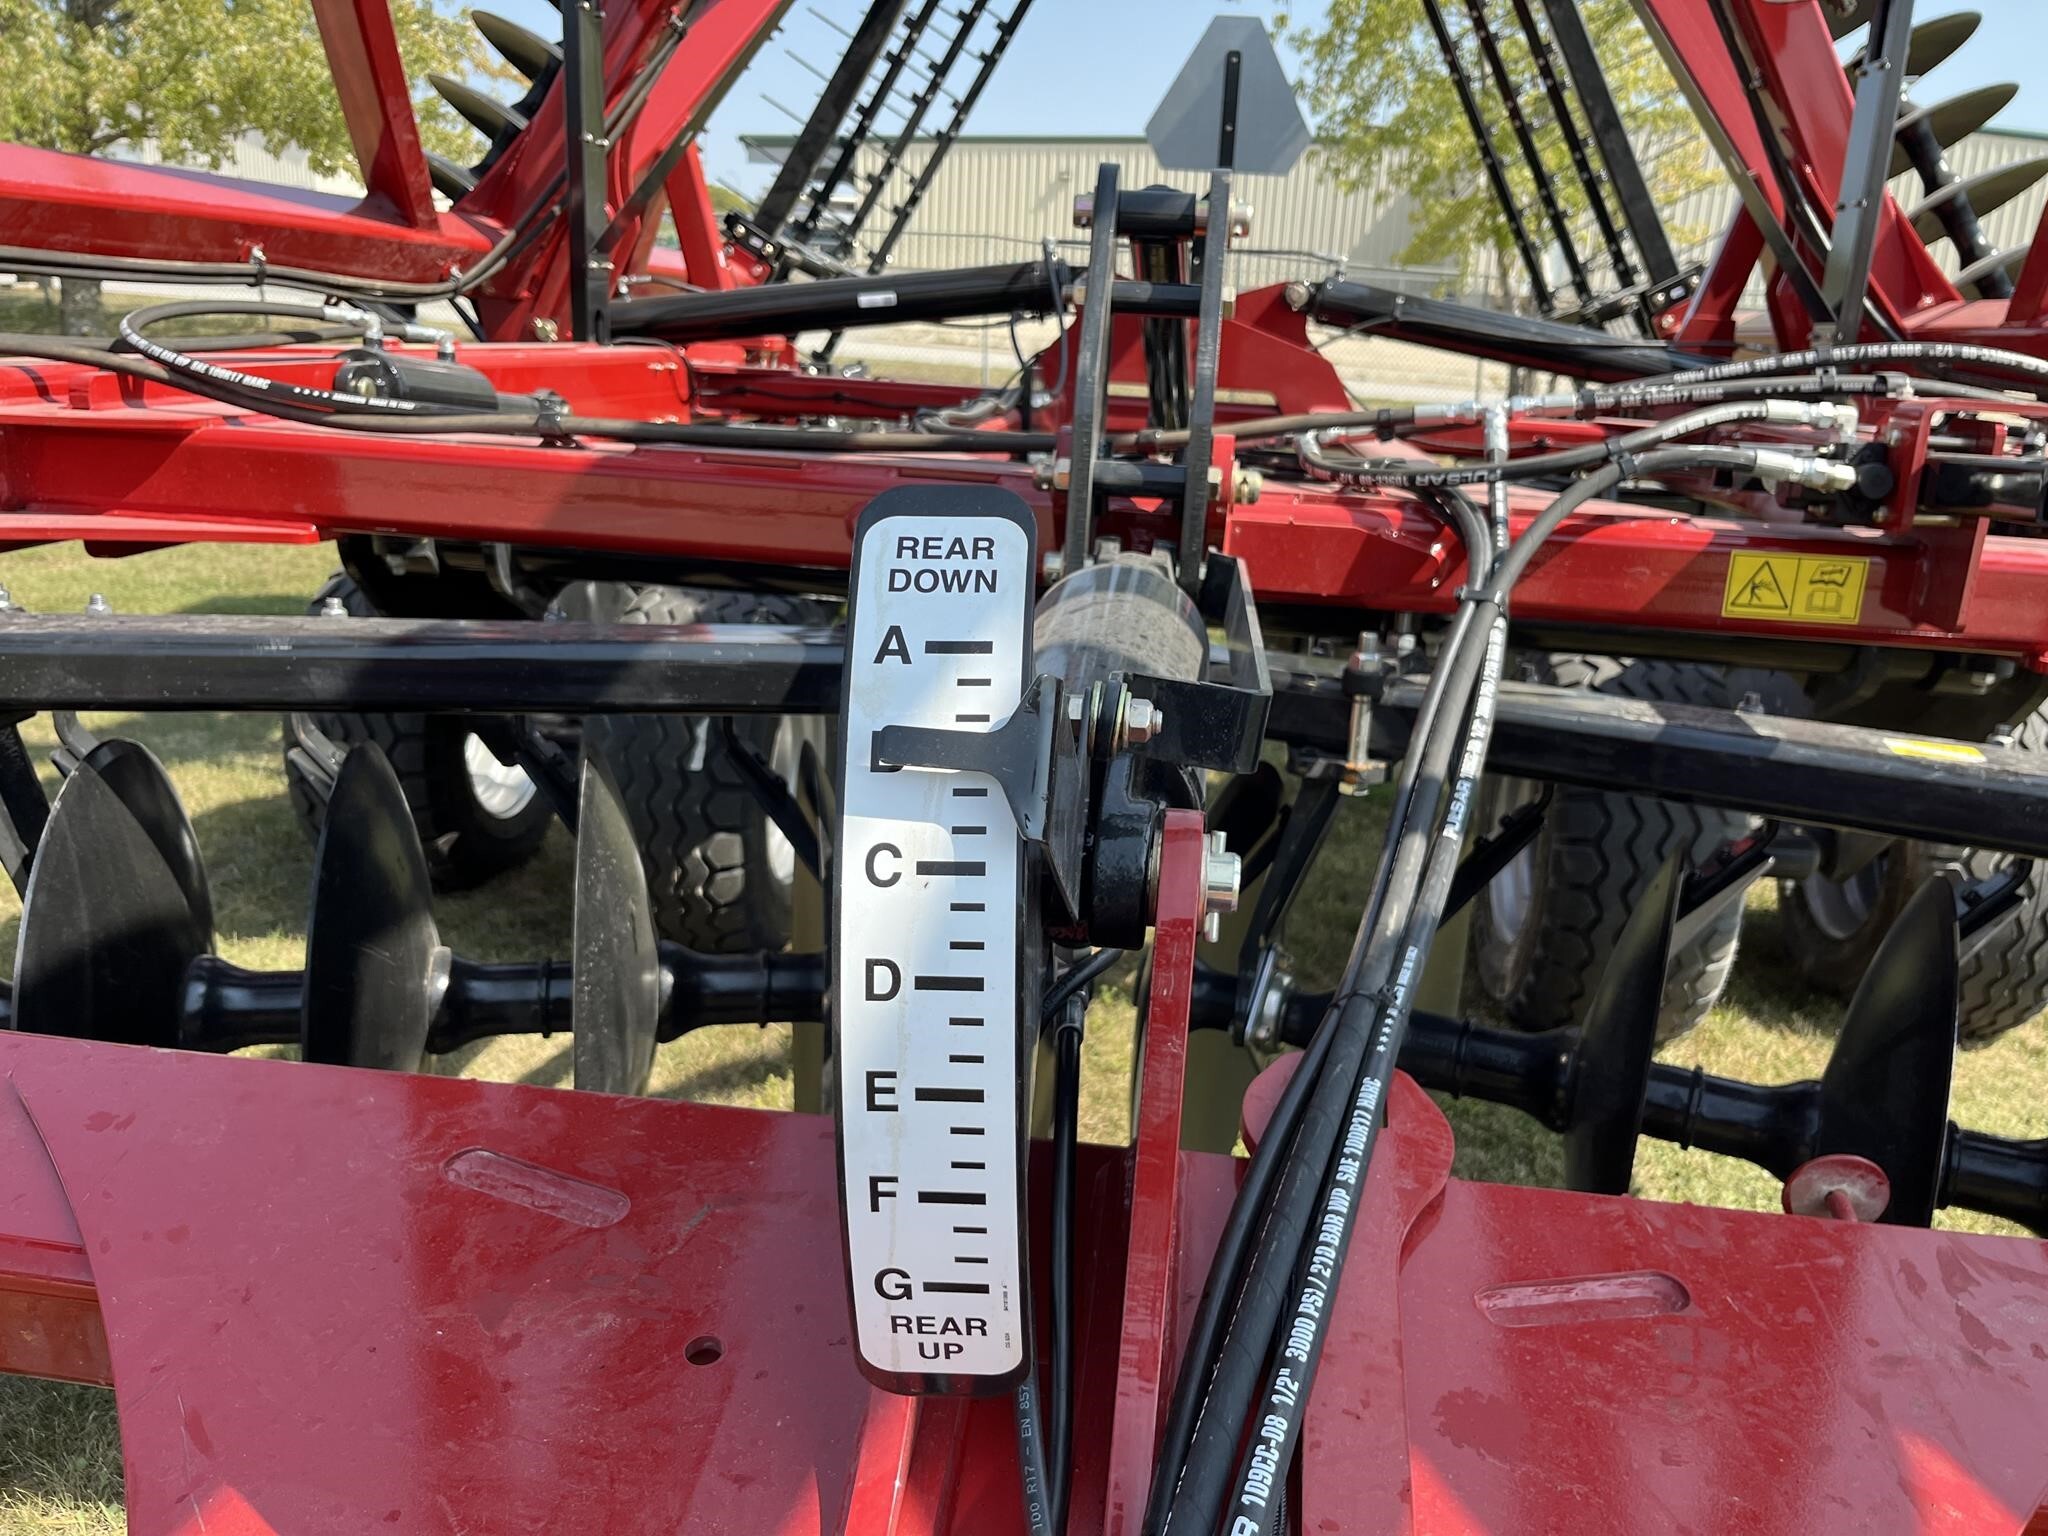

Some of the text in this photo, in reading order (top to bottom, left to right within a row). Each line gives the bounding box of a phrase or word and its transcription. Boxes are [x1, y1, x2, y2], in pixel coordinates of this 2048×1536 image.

[896, 536, 995, 561] REAR
[888, 568, 998, 594] DOWN
[873, 625, 913, 665] A
[1442, 780, 1473, 840] PULSAR
[864, 842, 903, 888] C
[864, 958, 902, 1002] D
[865, 1070, 899, 1112] E
[1356, 1076, 1381, 1110] HARC
[1343, 1109, 1372, 1156] 100R17
[1336, 1157, 1360, 1184] SAE
[869, 1176, 899, 1212] F
[1327, 1187, 1351, 1214] WP
[1318, 1213, 1345, 1247] BAR
[1310, 1245, 1336, 1278] 210
[873, 1267, 913, 1301] G
[1307, 1276, 1327, 1290] /
[1298, 1288, 1325, 1318] PSI
[890, 1315, 989, 1337] REAR
[1285, 1317, 1316, 1363] 3000
[918, 1342, 964, 1360] UP
[1018, 1384, 1030, 1410] 857
[1271, 1368, 1299, 1406] 1/2"
[1021, 1416, 1032, 1438] EN
[1241, 1414, 1288, 1507] 109CC-08
[1024, 1465, 1038, 1494] R17
[1030, 1502, 1044, 1531] 100
